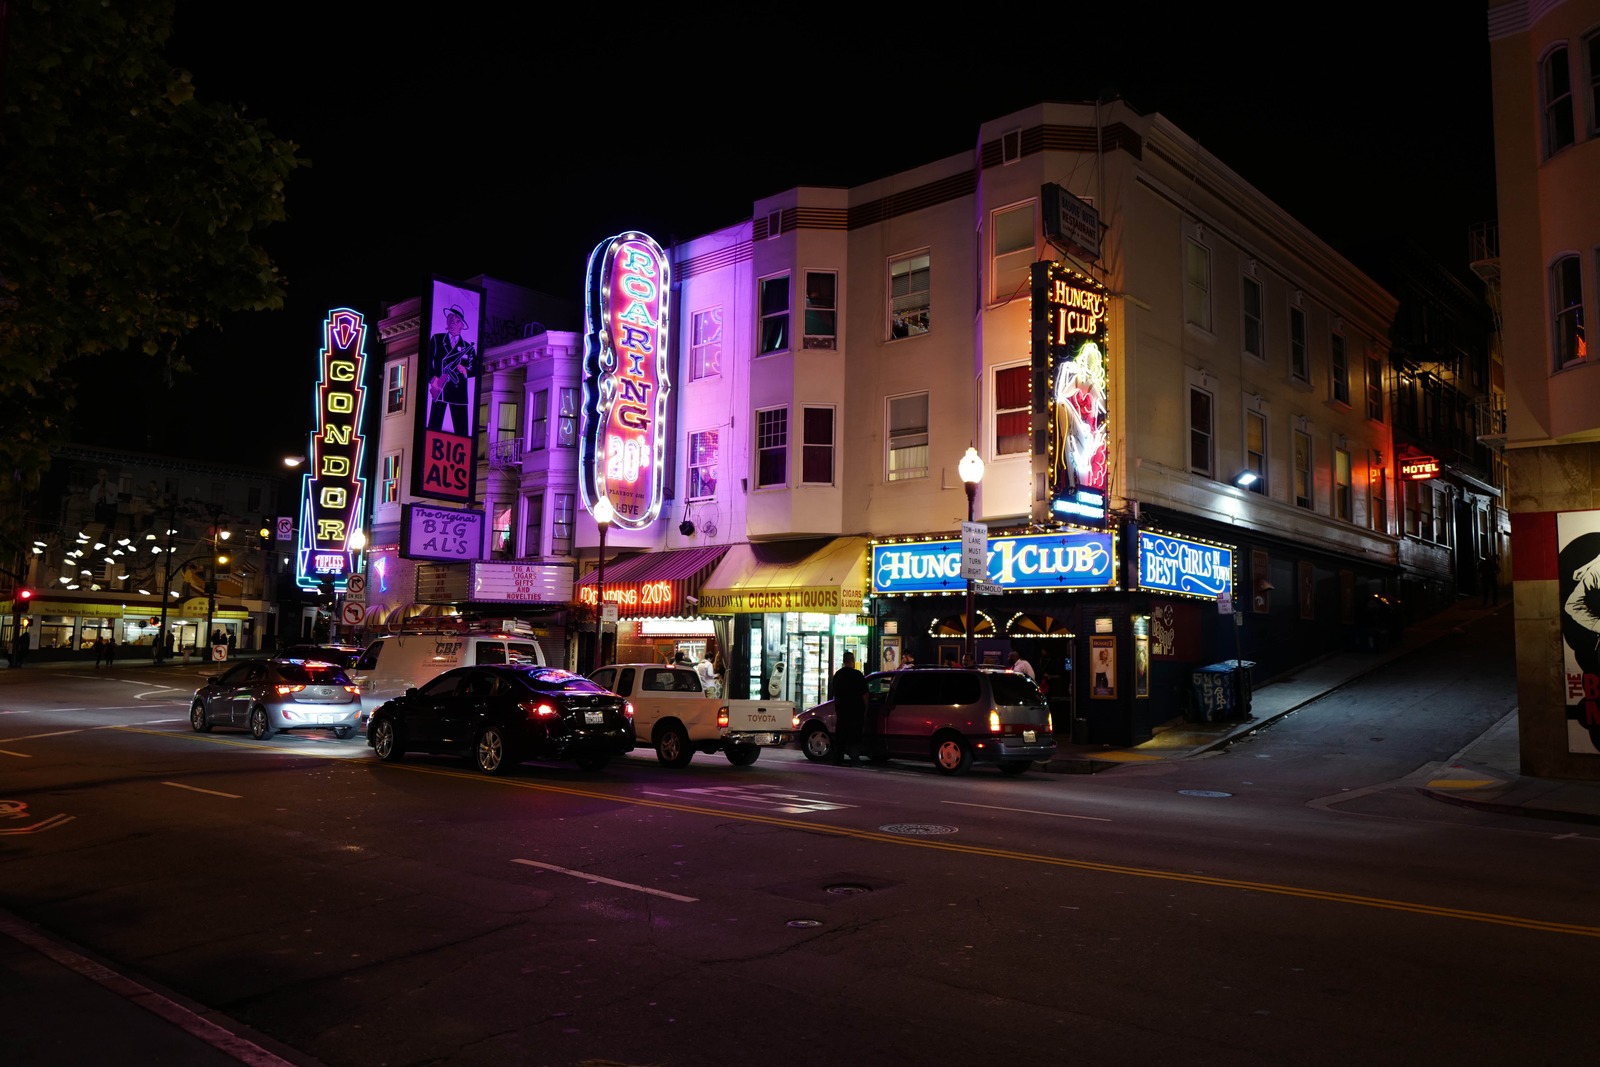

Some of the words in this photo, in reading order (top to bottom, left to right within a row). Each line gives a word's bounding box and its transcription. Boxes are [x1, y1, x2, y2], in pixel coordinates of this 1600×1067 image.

[1055, 280, 1104, 319] HUNGRY
[1058, 308, 1067, 345] I
[1067, 311, 1097, 335] CLUB
[618, 246, 658, 431] ROARING
[317, 361, 355, 541] CONDOR
[431, 438, 467, 465] BIG
[1402, 463, 1439, 474] HOTEL
[425, 463, 467, 491] AL'S
[416, 509, 434, 518] The
[434, 512, 478, 523] Original
[422, 519, 467, 539] BIG
[963, 525, 987, 534] TOW-AWAY
[423, 537, 468, 554] AL'S
[968, 537, 981, 545] LANE
[1142, 537, 1155, 550] The
[968, 547, 981, 555] MUST
[1212, 550, 1221, 565] IN
[315, 554, 345, 569] TOPLESS
[969, 557, 981, 565] TURN
[1018, 542, 1110, 576] CLUB
[1145, 551, 1179, 586] BEST
[1178, 544, 1212, 578] GIRLS
[513, 572, 537, 580] CIGARS
[967, 567, 981, 576] RIGHT
[1212, 565, 1231, 581] TOWN
[515, 579, 534, 587] GIFTS
[976, 583, 1002, 594] ROMOLO
[506, 593, 542, 601] NOVELTIES
[641, 581, 671, 604] 20's
[700, 594, 744, 608] BROADWAY
[748, 591, 783, 609] CIGARS
[785, 591, 792, 608] &
[794, 590, 838, 608] LIQUORS
[842, 589, 862, 598] CIGARS
[845, 599, 863, 608] LIQUORS
[1567, 673, 1582, 699] THE
[747, 714, 777, 722] TOYOTA
